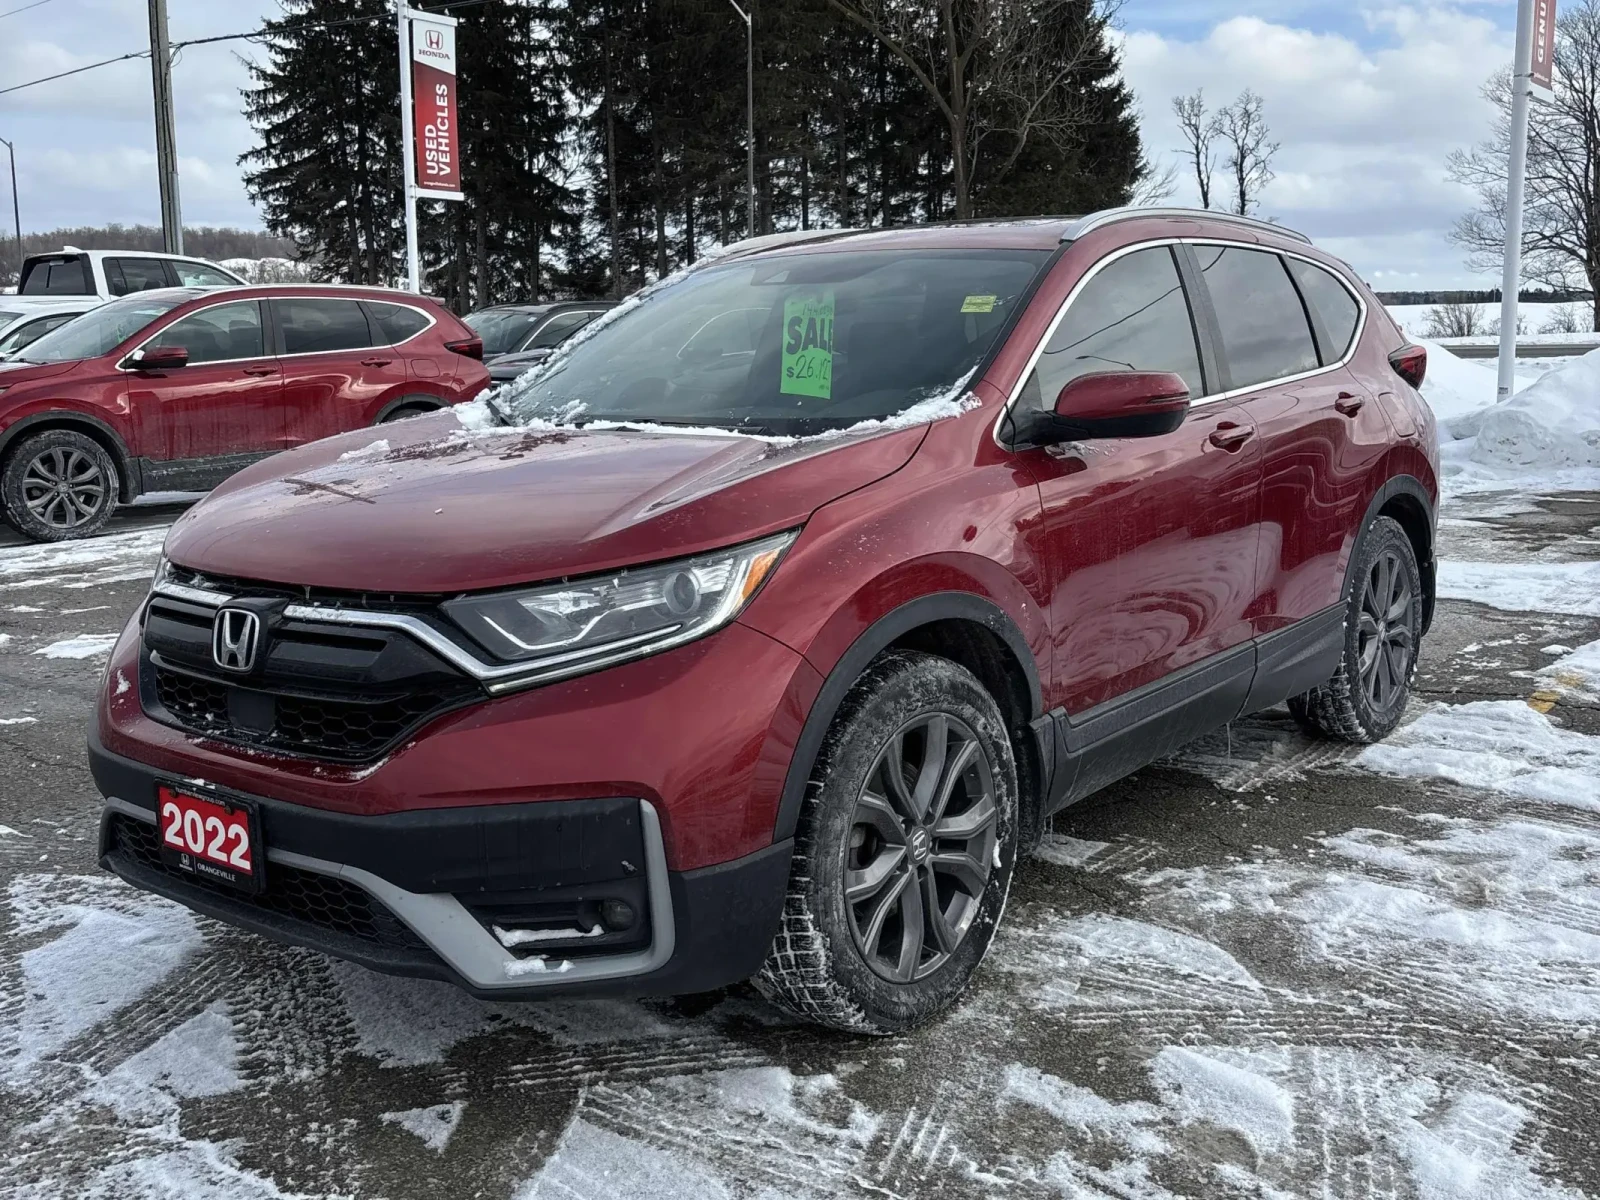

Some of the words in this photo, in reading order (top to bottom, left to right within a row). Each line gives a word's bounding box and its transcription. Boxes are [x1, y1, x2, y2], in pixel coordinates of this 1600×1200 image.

[418, 49, 450, 60] HONDA
[425, 124, 439, 174] USED
[436, 83, 451, 176] VEHICLES
[163, 802, 251, 871] 2022
[197, 862, 236, 882] ORANGEVILLE
